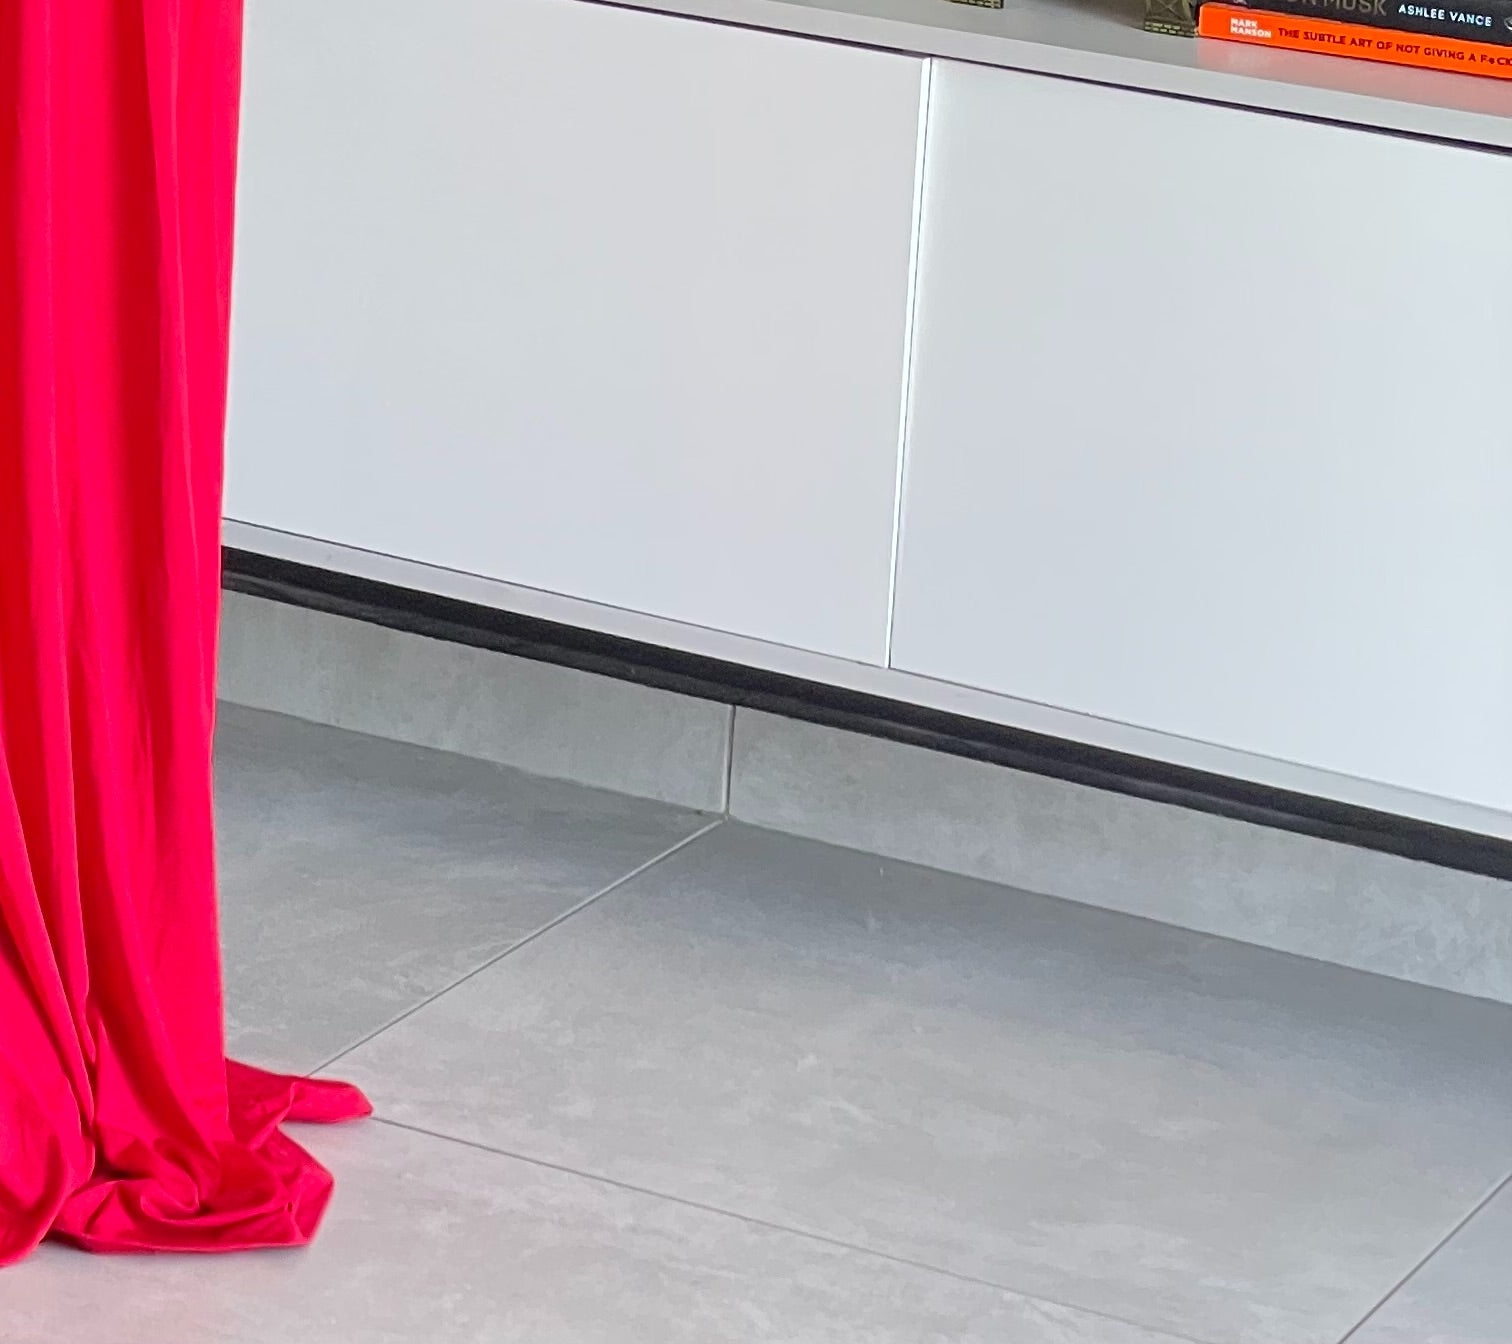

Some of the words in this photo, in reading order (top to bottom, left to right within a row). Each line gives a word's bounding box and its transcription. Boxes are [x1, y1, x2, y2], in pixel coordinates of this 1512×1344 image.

[1230, 17, 1258, 28] MARK
[1399, 4, 1445, 20] ASHLEE
[1450, 12, 1492, 27] VANCE
[1230, 27, 1272, 38] MANSON
[1278, 27, 1300, 39] THE
[1303, 30, 1346, 46] SUBTLE
[1350, 36, 1373, 48] ART
[1376, 41, 1392, 51] OF
[1396, 43, 1421, 55] NOT
[1424, 46, 1464, 62] GIVING
[1468, 52, 1476, 62] A
